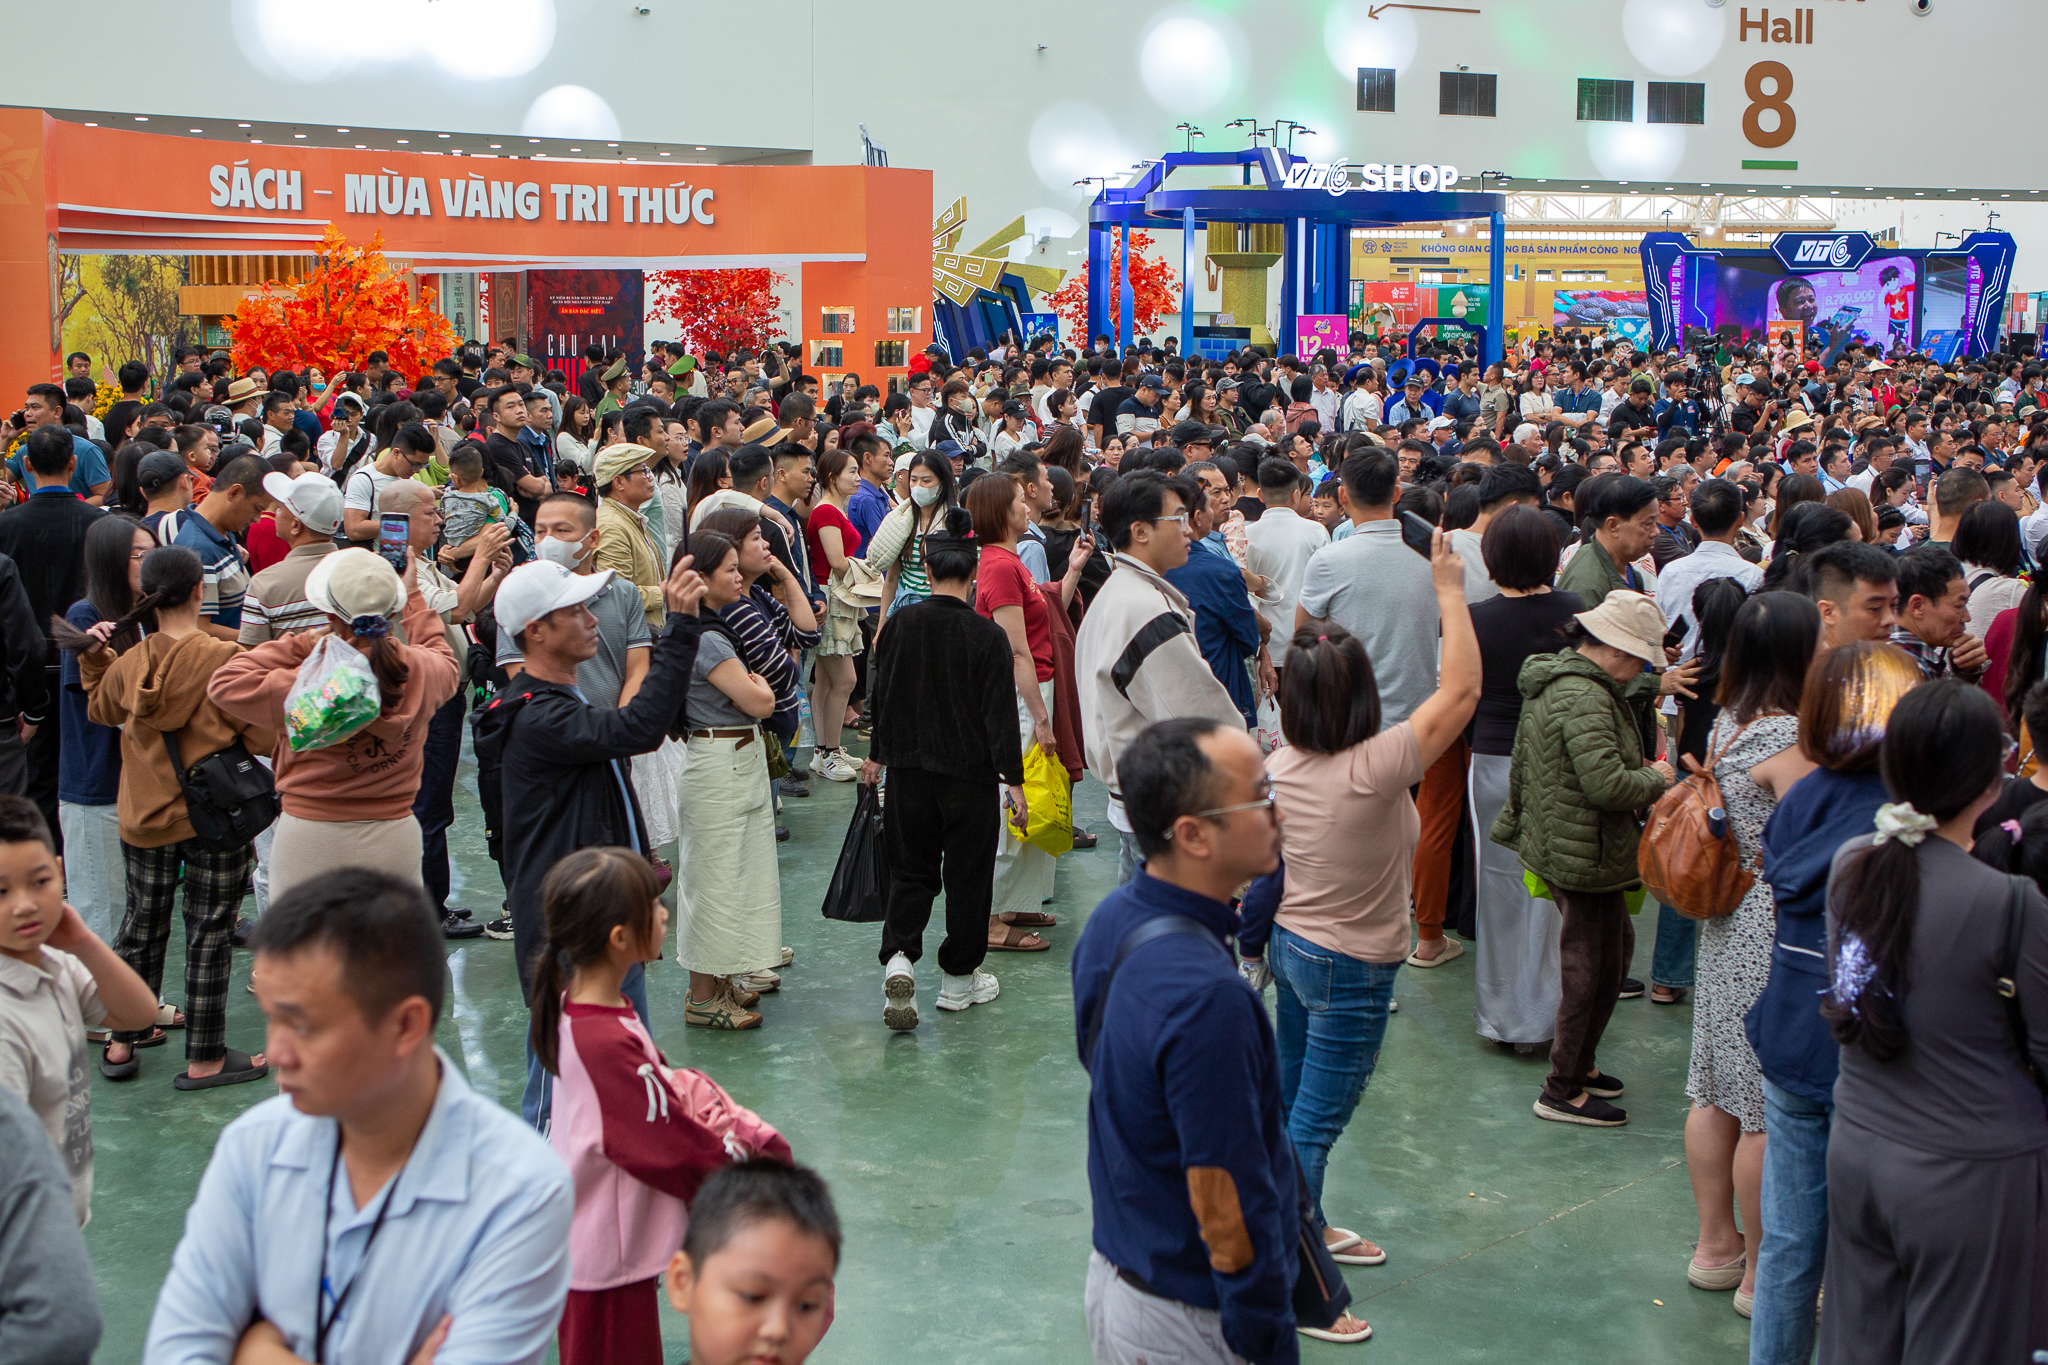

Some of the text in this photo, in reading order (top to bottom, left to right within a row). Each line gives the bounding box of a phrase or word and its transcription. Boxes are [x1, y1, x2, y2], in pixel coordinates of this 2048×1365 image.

[1740, 8, 1813, 44] Hall
[1742, 60, 1796, 148] 8
[209, 159, 303, 211] SÁCH
[344, 167, 430, 216] MÙA
[439, 172, 540, 220] VÀNG
[550, 184, 607, 222] TRI
[618, 180, 714, 225] THỨC
[1282, 157, 1459, 197] VTC SHOP
[1421, 243, 1456, 253] KHÔNG
[1458, 245, 1482, 253] GIAN
[1484, 245, 1519, 254] QNG
[1521, 243, 1535, 254] BÁ
[1537, 243, 1557, 254] SẢN
[1559, 242, 1588, 254] PHẨM
[1589, 244, 1619, 254] CÔNG
[1793, 235, 1852, 267] VTC
[547, 334, 577, 357] CHU
[1300, 335, 1322, 355] 12
